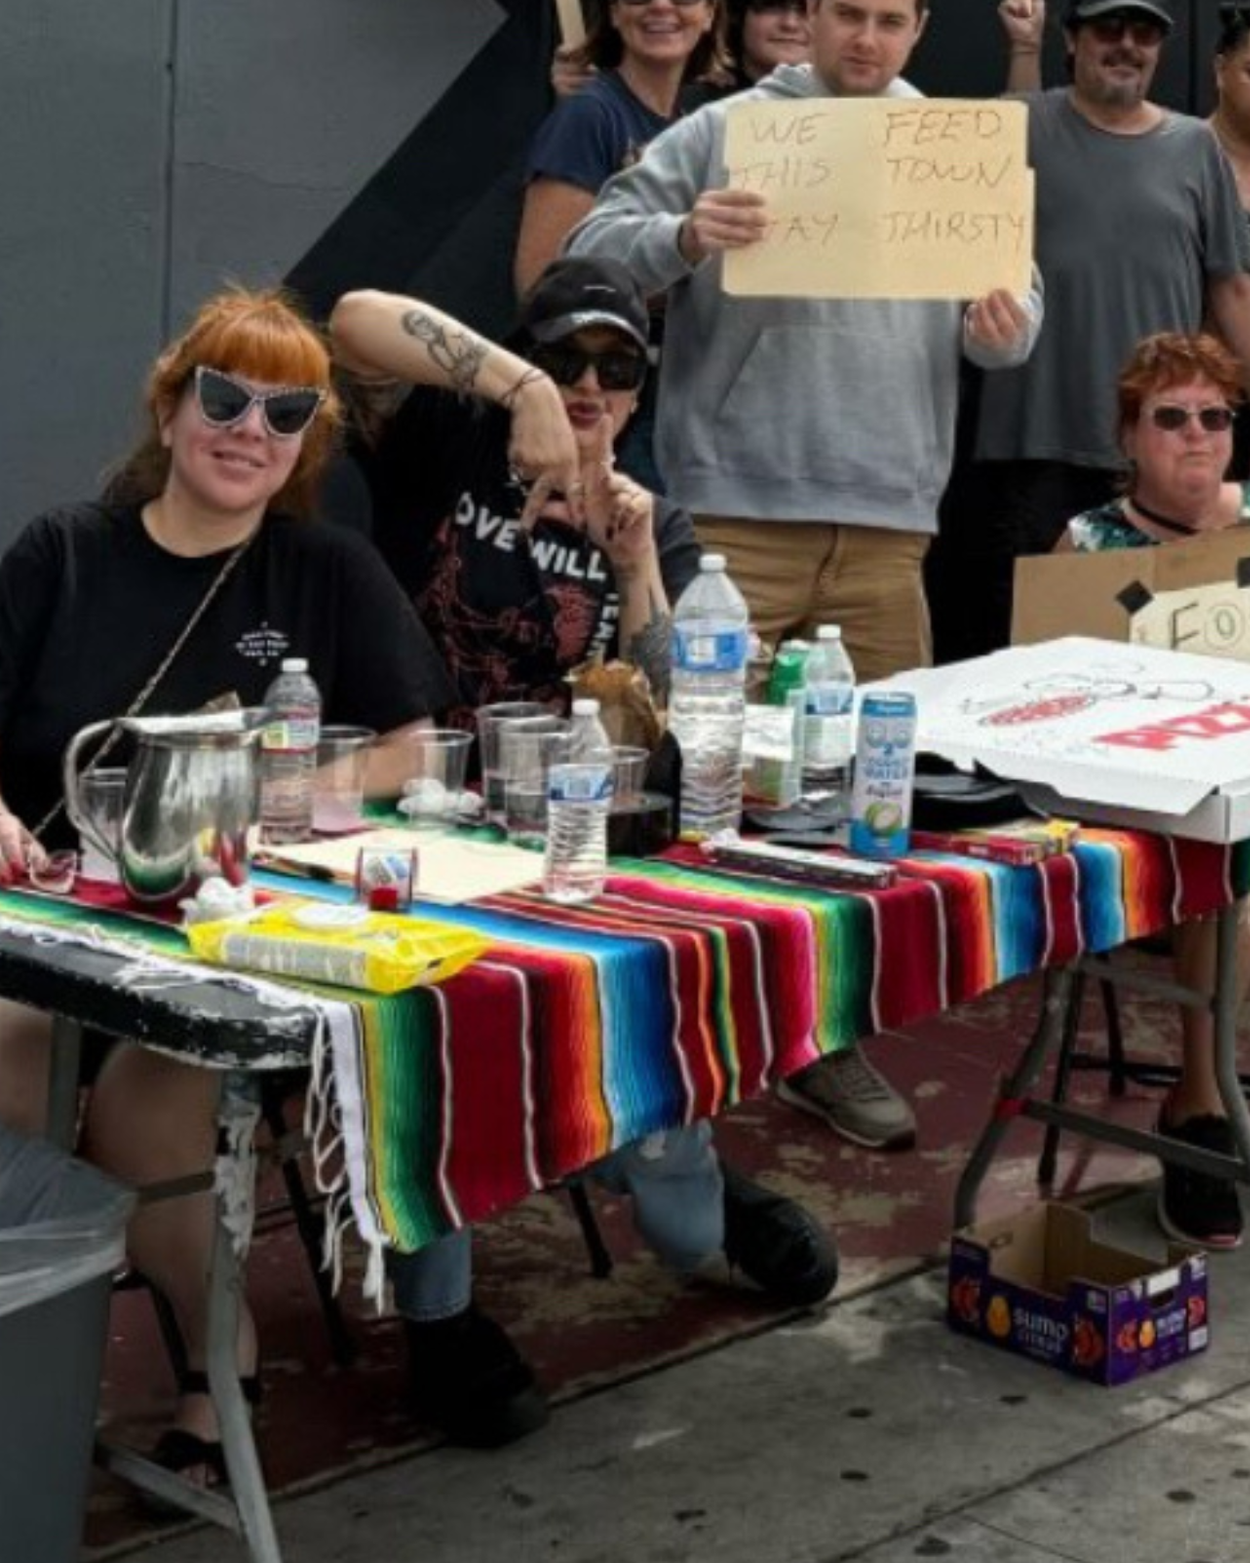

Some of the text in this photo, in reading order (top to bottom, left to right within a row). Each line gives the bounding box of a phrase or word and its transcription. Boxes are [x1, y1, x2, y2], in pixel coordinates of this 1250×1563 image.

[750, 108, 1002, 147] WE FEED
[734, 155, 1014, 189] THIS TOWN
[882, 209, 1026, 252] THIRSTY
[455, 492, 607, 582] OVE WILL
